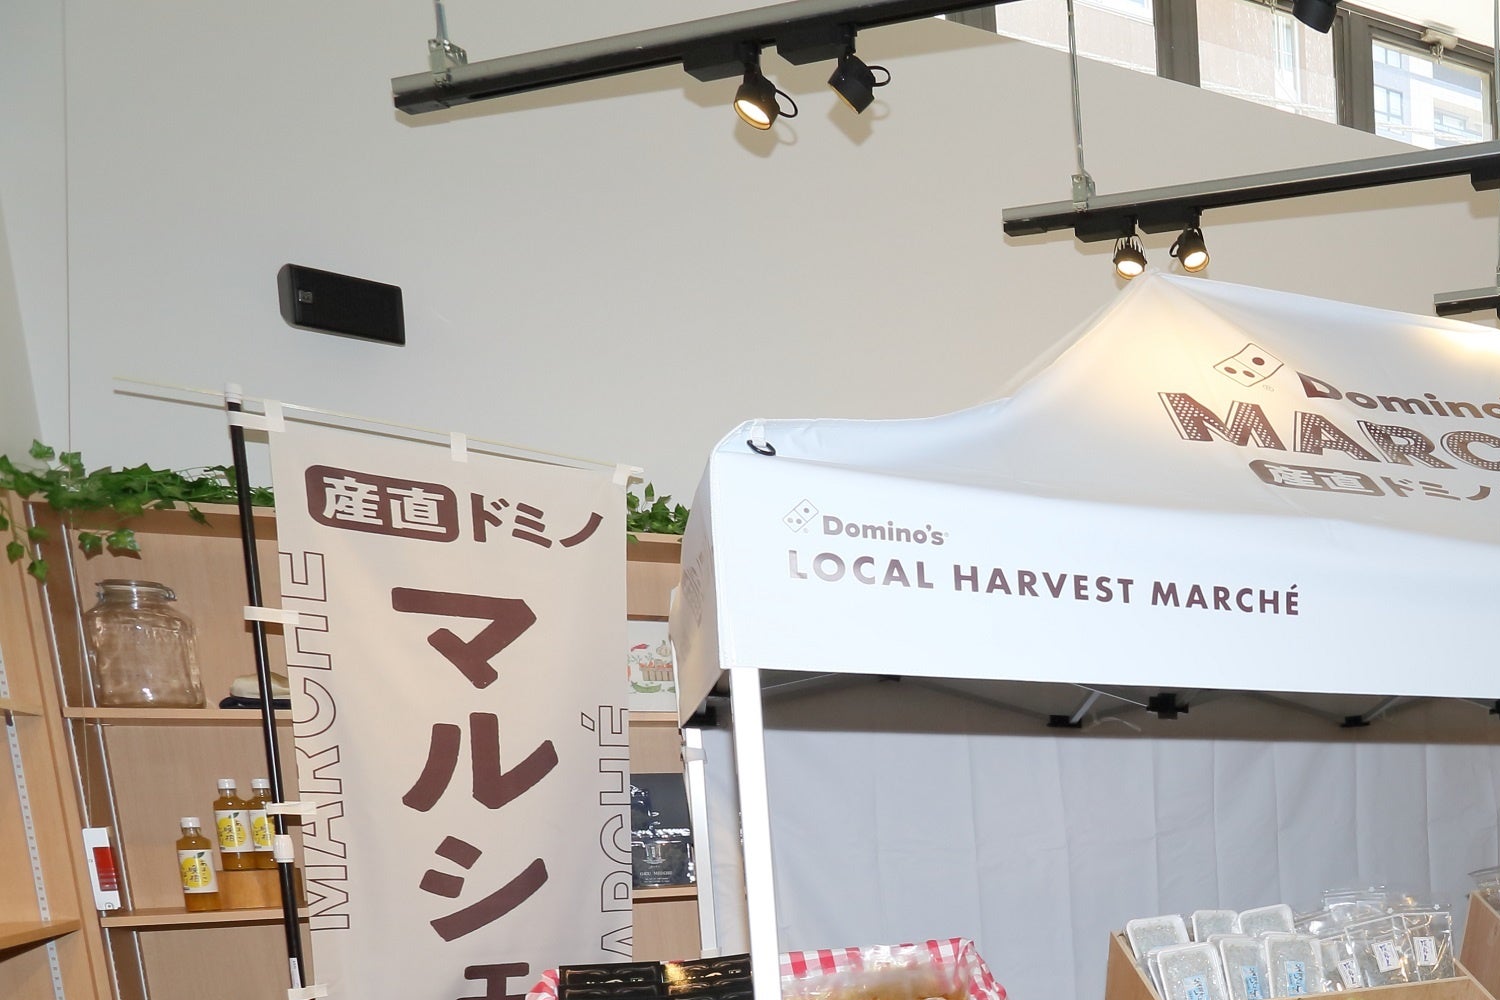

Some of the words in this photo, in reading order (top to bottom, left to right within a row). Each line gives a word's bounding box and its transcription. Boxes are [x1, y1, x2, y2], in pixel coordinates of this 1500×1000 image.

[822, 514, 945, 547] Domino's
[788, 549, 934, 589] LOCAL
[953, 563, 1134, 605] HARVEST
[1151, 583, 1300, 616] MARCHÉ
